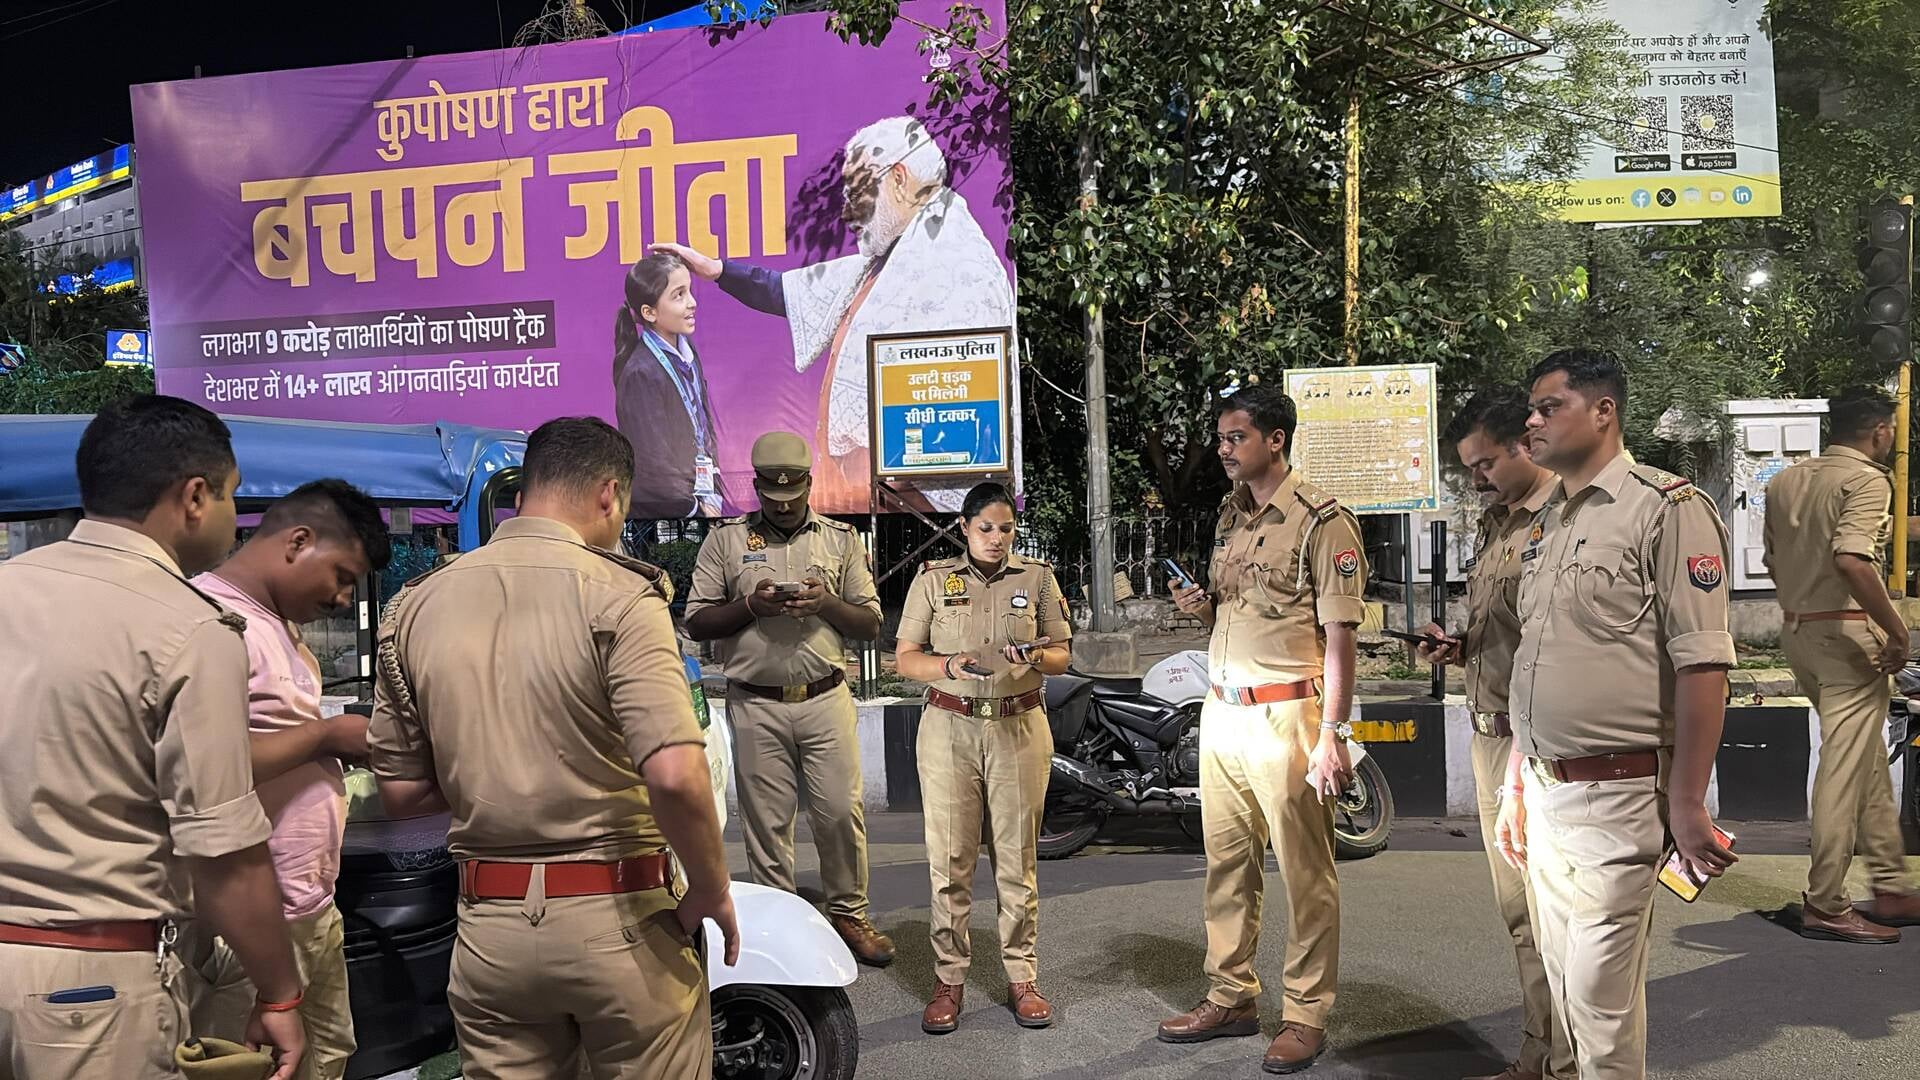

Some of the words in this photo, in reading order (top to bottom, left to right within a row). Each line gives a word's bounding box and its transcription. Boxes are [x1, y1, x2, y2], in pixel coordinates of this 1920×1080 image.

[1632, 36, 1647, 47] पर
[1651, 35, 1684, 47] अपग्रेड
[1686, 34, 1698, 47] हों
[1702, 33, 1722, 46] और
[1725, 33, 1751, 46] अपने
[1670, 50, 1683, 62] को
[1687, 50, 1716, 63] बेहतर
[1658, 70, 1716, 86] डाउनलोड
[1720, 68, 1747, 85] करें!
[374, 80, 517, 162] कुपोषण
[523, 77, 609, 132] हारा
[1631, 162, 1654, 171] Google
[1654, 161, 1668, 170] Play
[1698, 160, 1713, 168] App
[1713, 159, 1732, 167] Store
[240, 157, 534, 288] बचपन
[549, 106, 798, 264] जीता
[1588, 198, 1602, 206] us
[1606, 196, 1625, 205] on:
[200, 331, 262, 357] लगभग
[265, 329, 278, 354] 9
[281, 320, 331, 358] करोड़
[333, 312, 426, 350] लाभार्थियों
[428, 320, 454, 345] का
[457, 311, 510, 343] पोषण
[512, 308, 547, 345] ट्रैक
[900, 346, 953, 359] लखनऊ
[955, 341, 996, 359] पुलिस
[203, 372, 260, 403] देशभर
[262, 369, 281, 399] में
[284, 374, 319, 399] 14+
[322, 371, 373, 397] लाख
[377, 360, 489, 397] आंगनवाड़ियां
[491, 356, 561, 389] कार्यरत
[941, 370, 972, 386] सड़क
[911, 389, 927, 401] पर
[904, 407, 936, 424] सीधी
[937, 408, 977, 423] टक्कर
